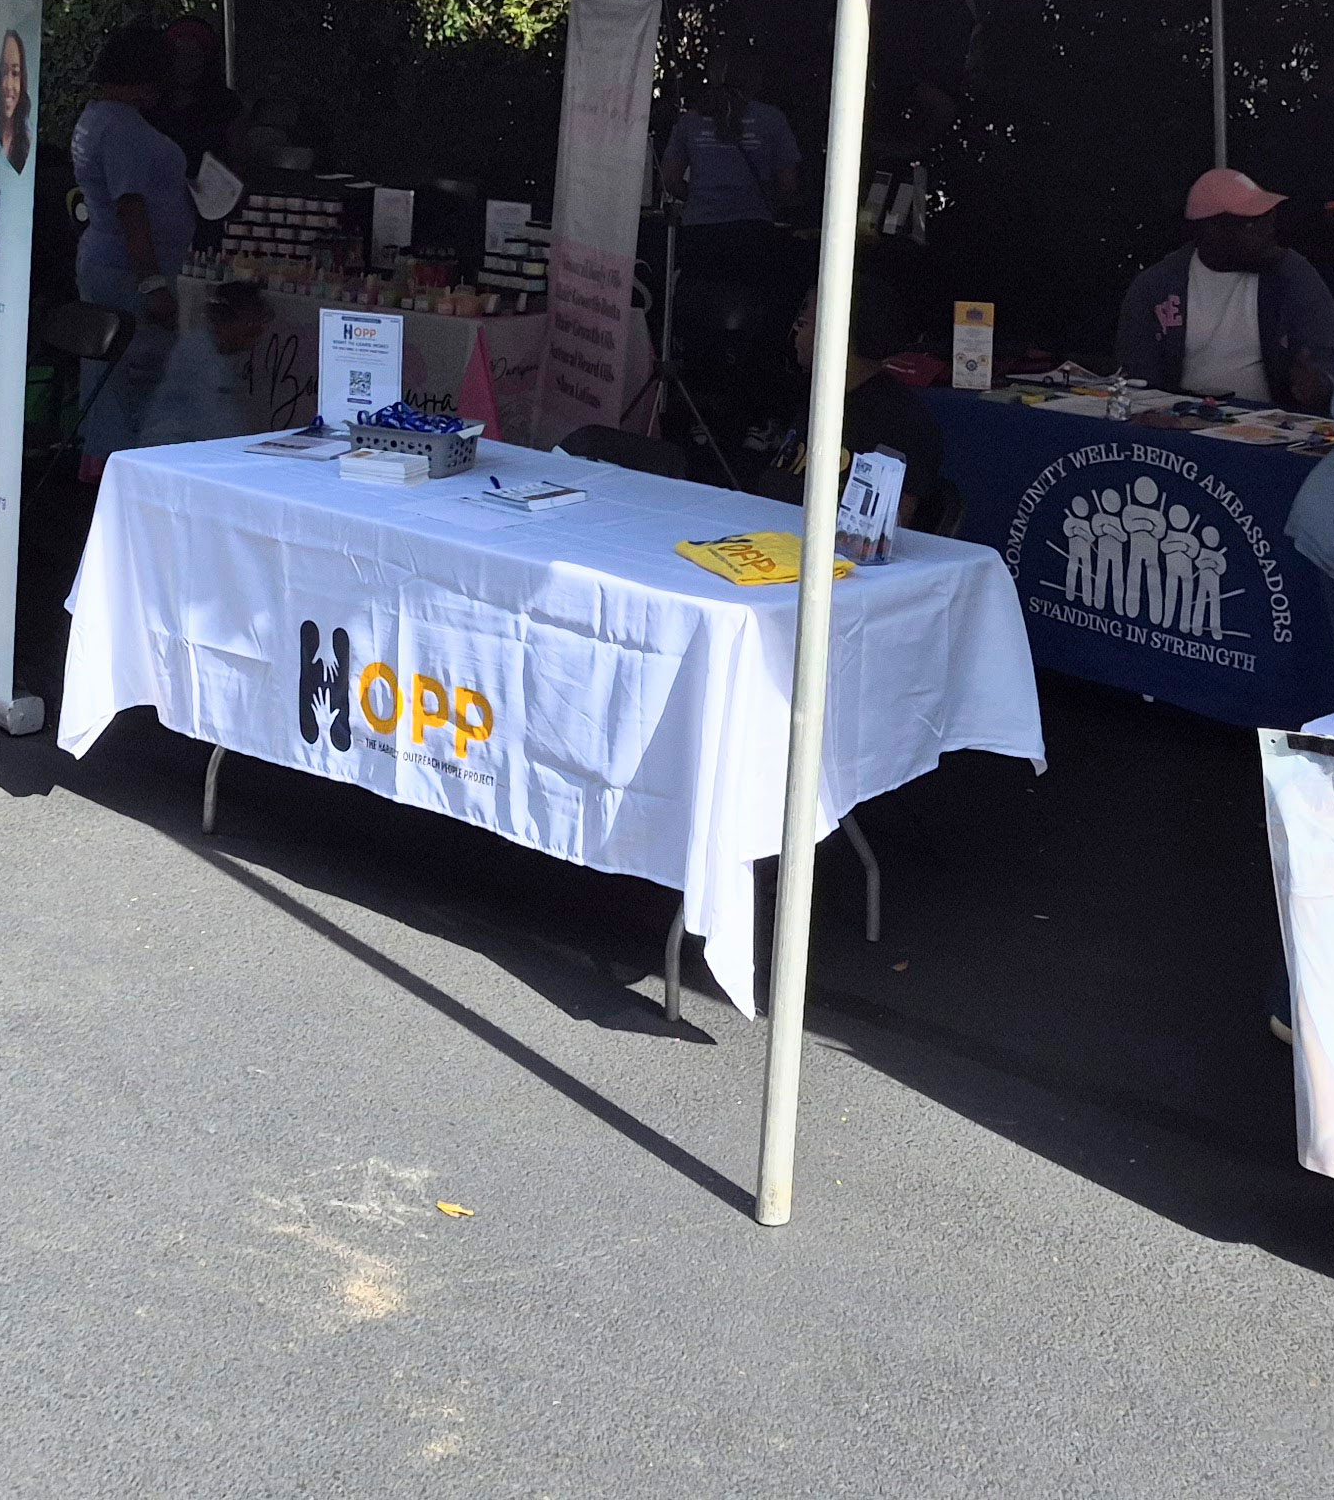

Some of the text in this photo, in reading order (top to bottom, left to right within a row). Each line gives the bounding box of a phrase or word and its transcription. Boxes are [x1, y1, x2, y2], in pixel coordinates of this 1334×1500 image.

[344, 324, 376, 339] HOPP
[1006, 460, 1069, 579] COMMUNITY
[1068, 442, 1199, 482] WELL-BEING
[1198, 474, 1293, 644] AMBASSADORS
[1028, 596, 1257, 673] STANDING IN STRENGTH
[299, 620, 495, 759] HOPP
[365, 738, 377, 751] THE
[402, 751, 442, 771] OUTREACH
[441, 759, 462, 780] PEOPLE
[463, 770, 495, 788] PROJECT
